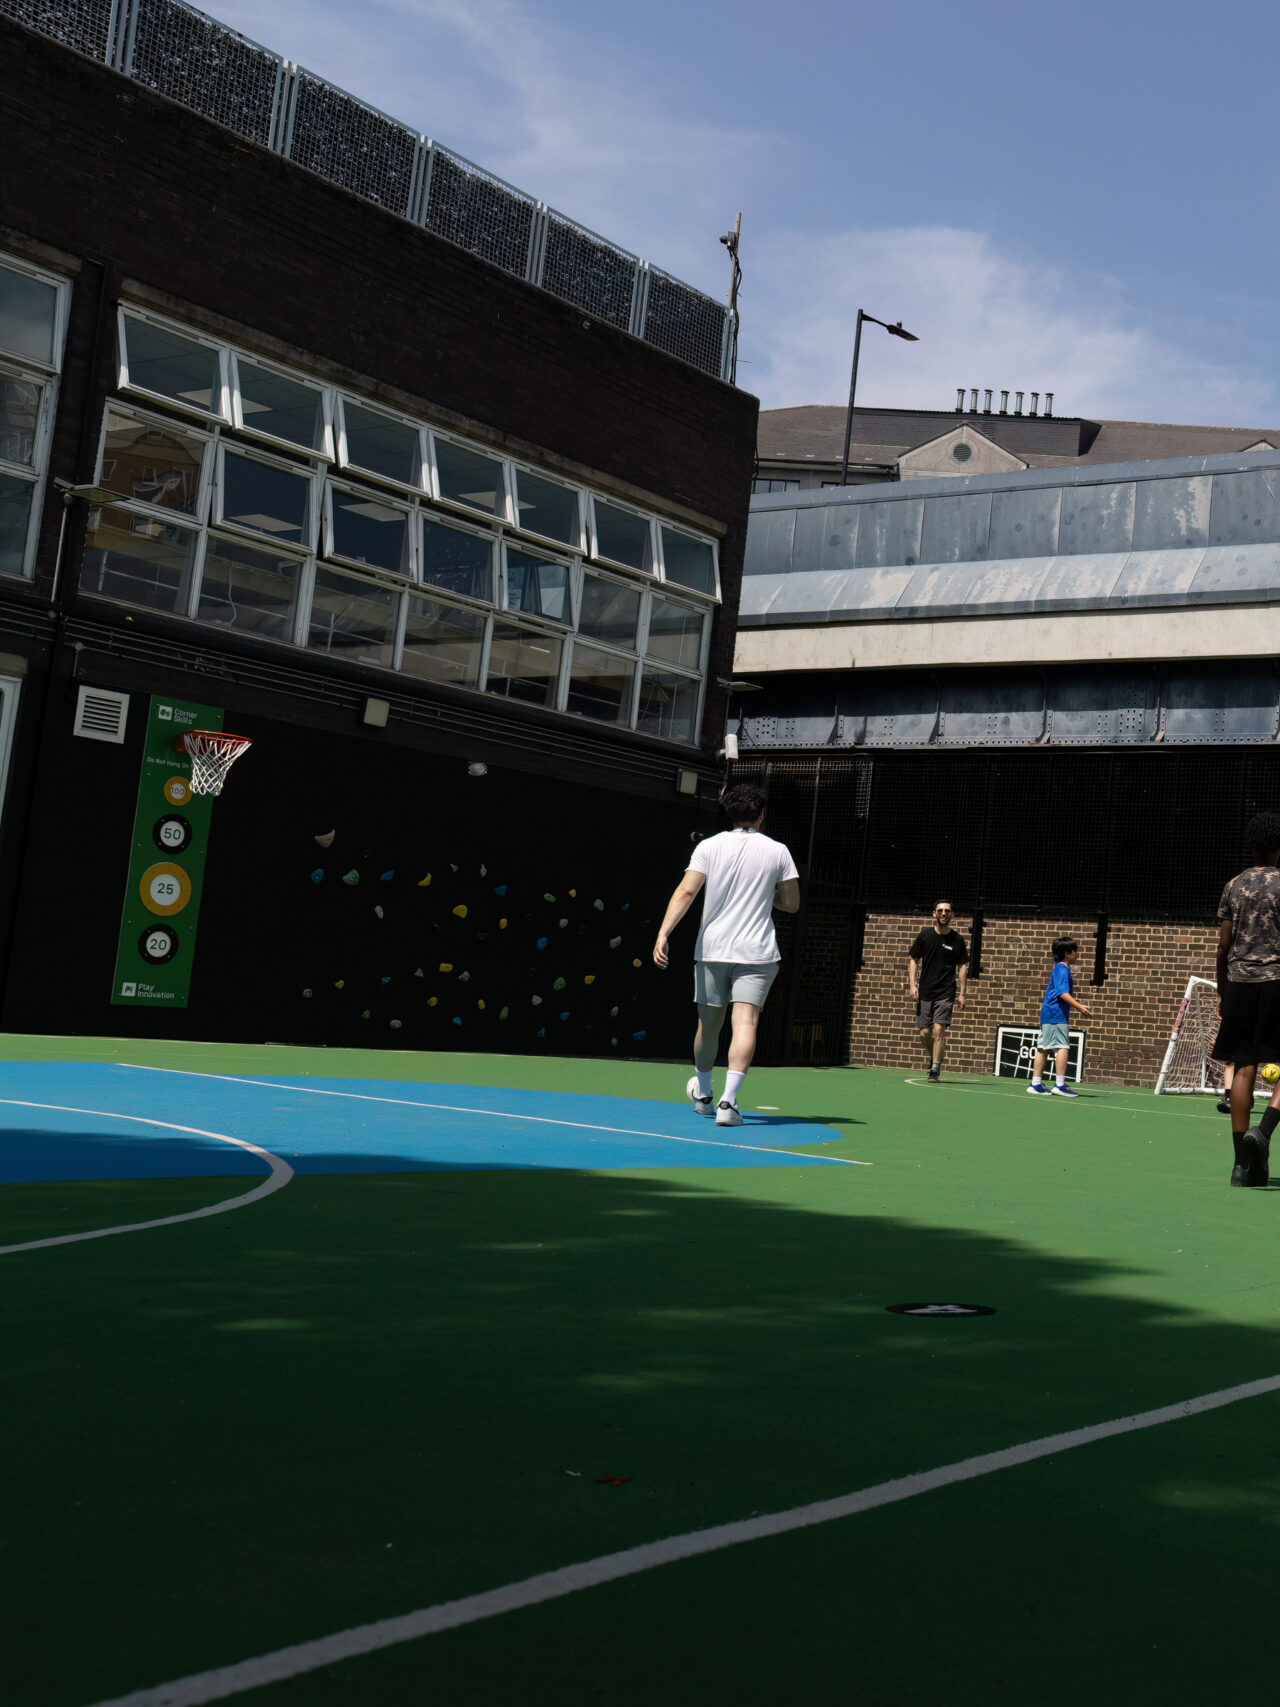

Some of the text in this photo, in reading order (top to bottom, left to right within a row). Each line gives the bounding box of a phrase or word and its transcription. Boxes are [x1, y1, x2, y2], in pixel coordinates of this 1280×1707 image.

[174, 708, 198, 719] Corner
[173, 715, 193, 724] Skills
[167, 760, 180, 769] Hang
[171, 787, 185, 796] 100
[164, 827, 181, 840] 50
[157, 882, 174, 895] 25
[150, 938, 167, 951] 20
[138, 983, 155, 992] Play
[137, 990, 175, 999] Innovation
